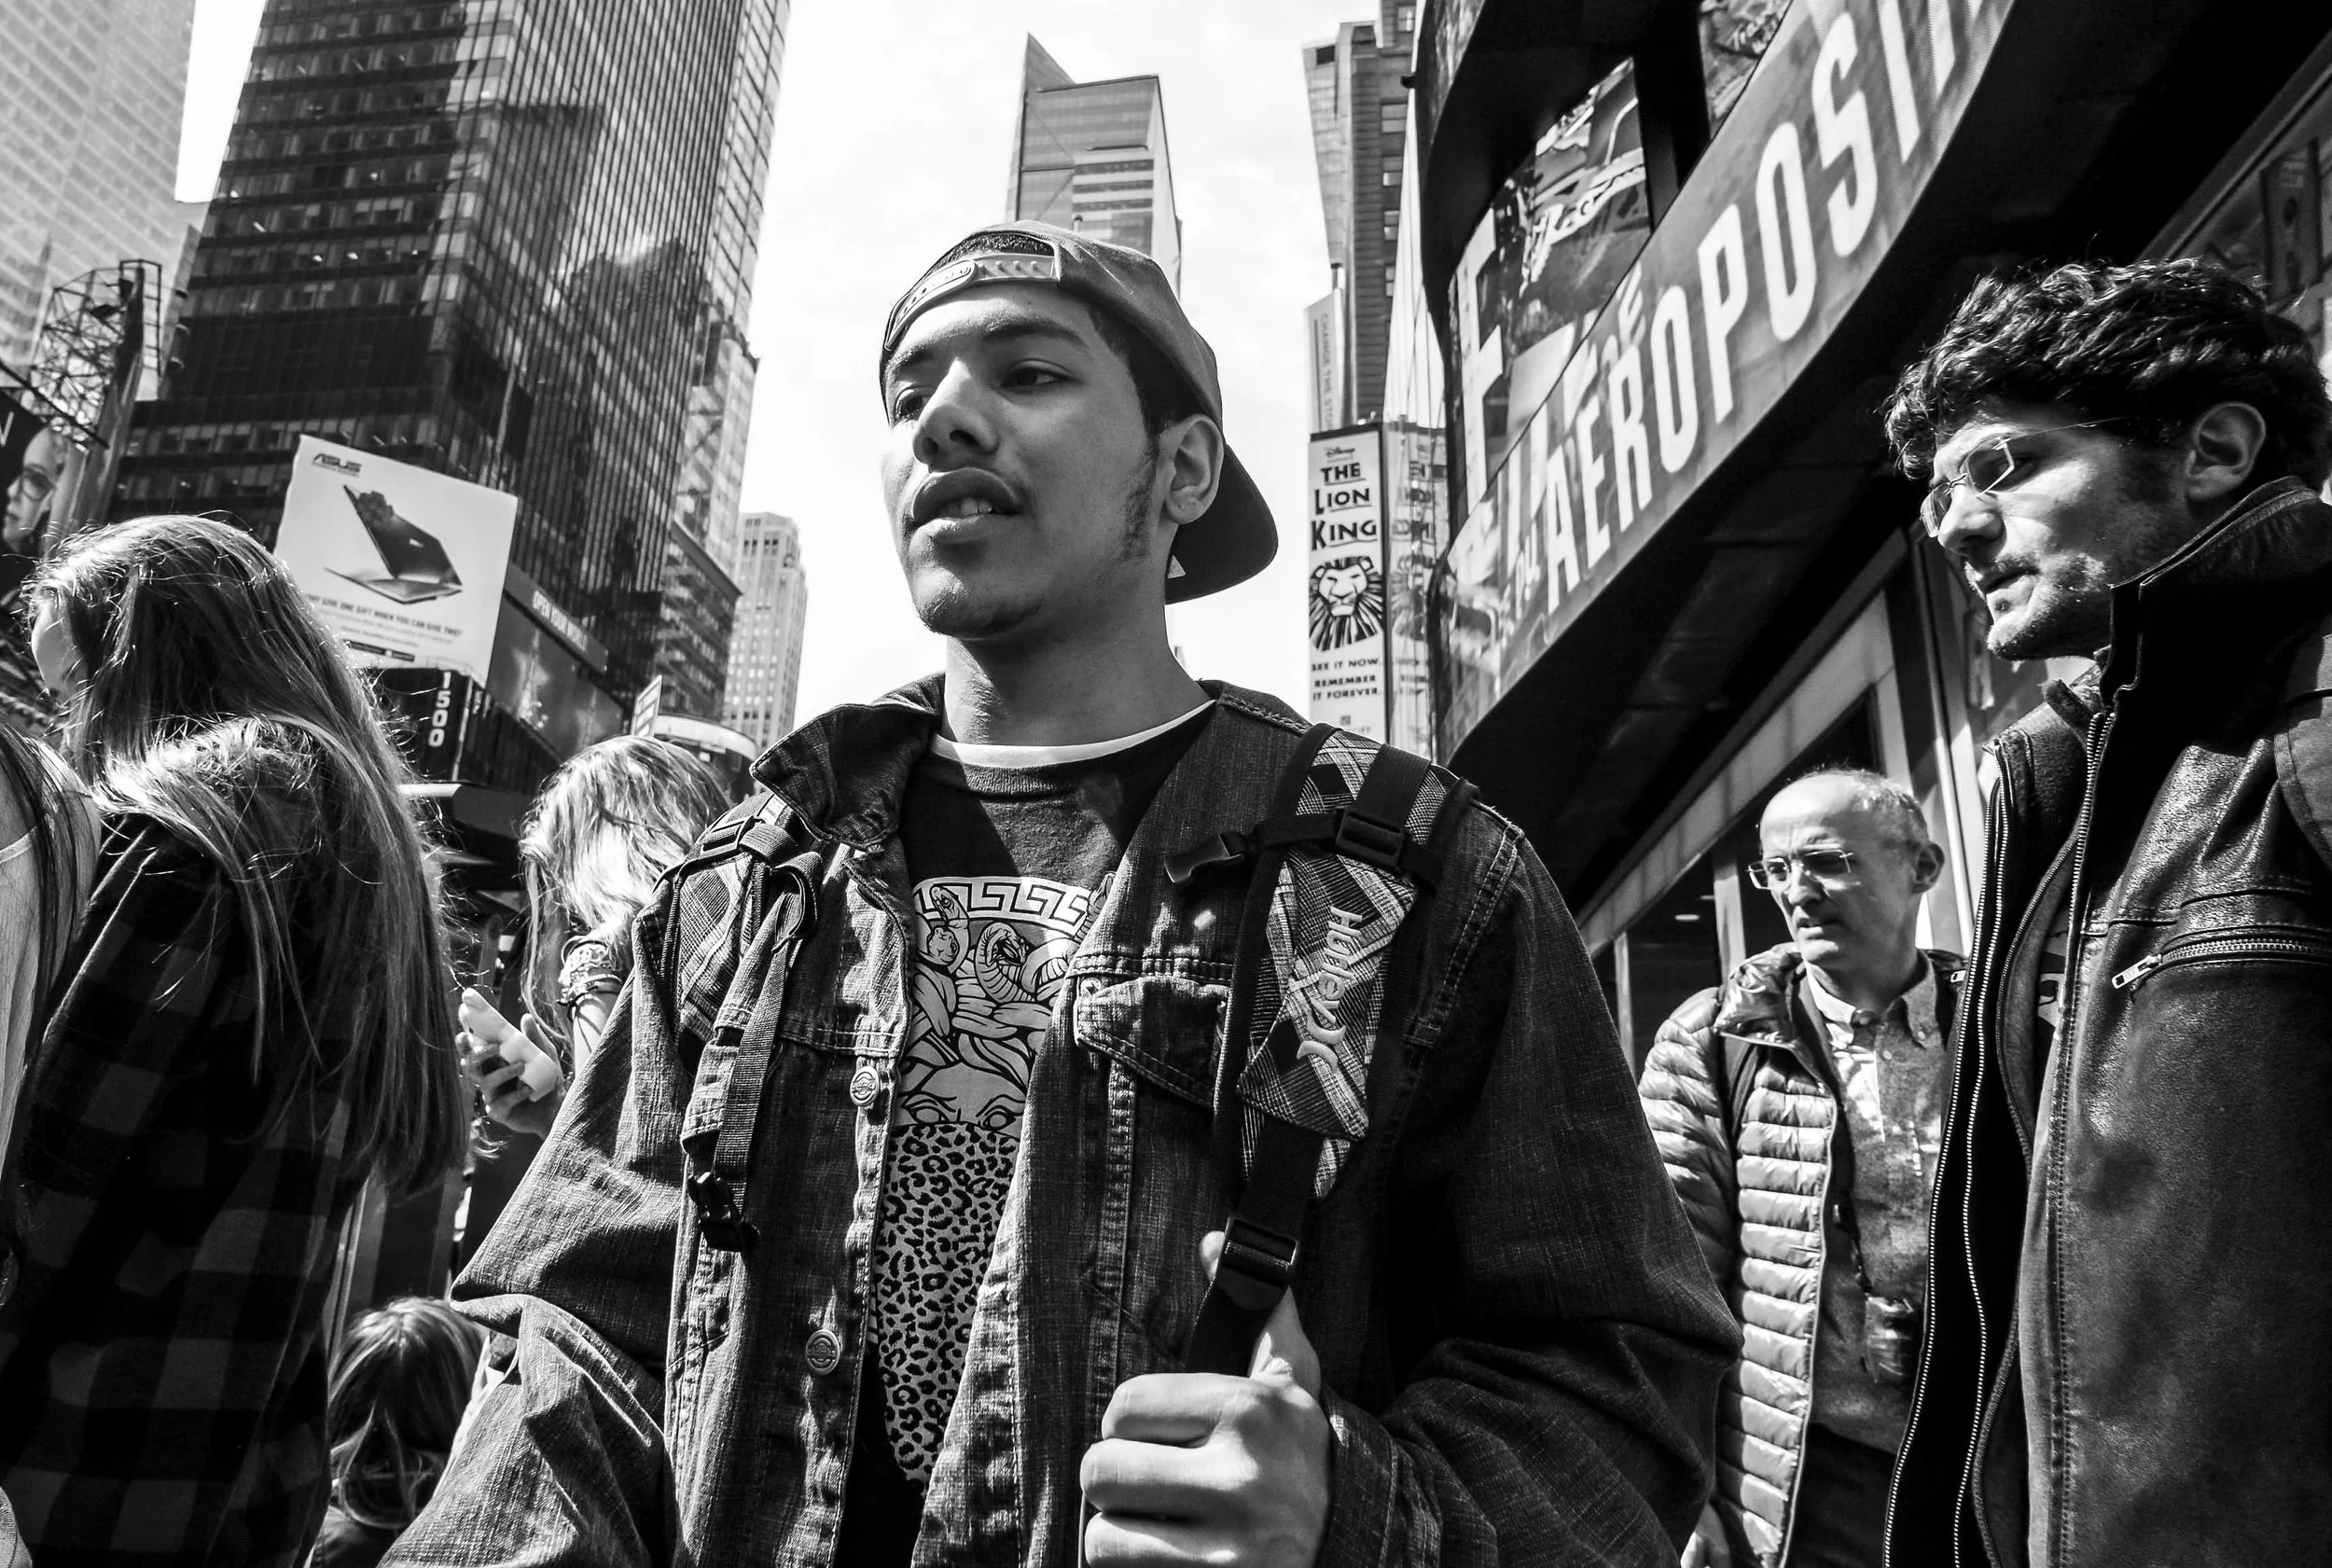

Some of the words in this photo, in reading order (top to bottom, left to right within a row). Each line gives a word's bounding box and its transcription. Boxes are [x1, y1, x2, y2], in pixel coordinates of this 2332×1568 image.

[312, 452, 362, 473] ASUS
[1320, 462, 1361, 482] THE
[1311, 662, 1329, 672] SEE
[1334, 660, 1343, 669] IT
[1313, 674, 1376, 687] REMEMBER
[1312, 691, 1322, 701] IT
[429, 671, 452, 747] 1500
[1309, 905, 1363, 1024] Hurley
